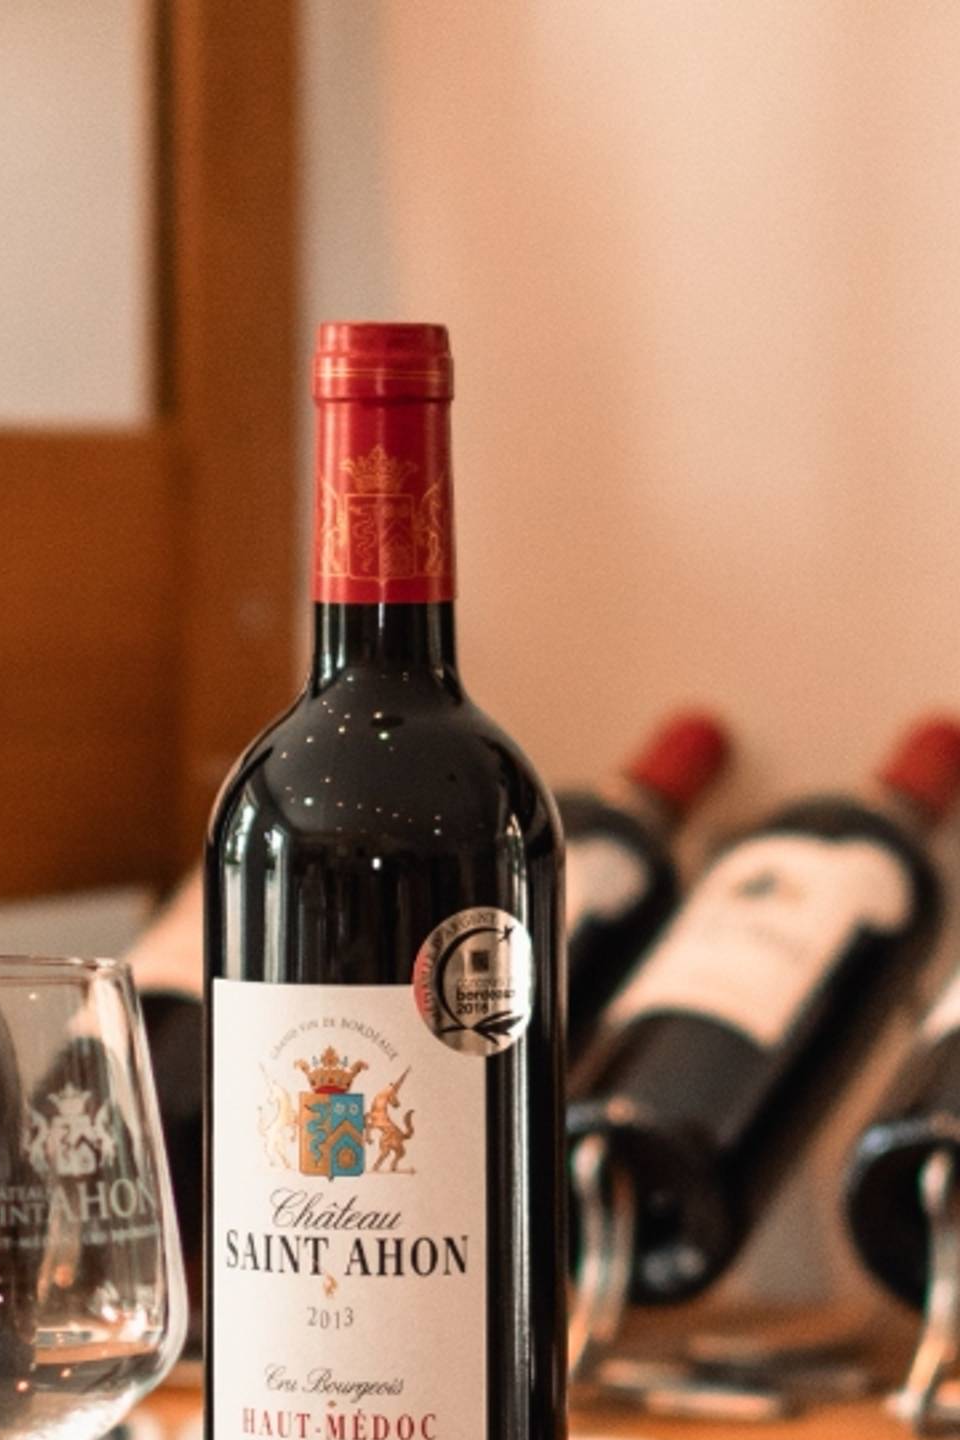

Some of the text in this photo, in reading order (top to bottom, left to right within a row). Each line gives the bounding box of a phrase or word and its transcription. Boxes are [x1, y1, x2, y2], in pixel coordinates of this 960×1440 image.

[269, 1187, 403, 1231] Château
[225, 1228, 470, 1277] SAINT AHON
[305, 1306, 355, 1330] 2013
[263, 1363, 405, 1404] Cru Bourgeois
